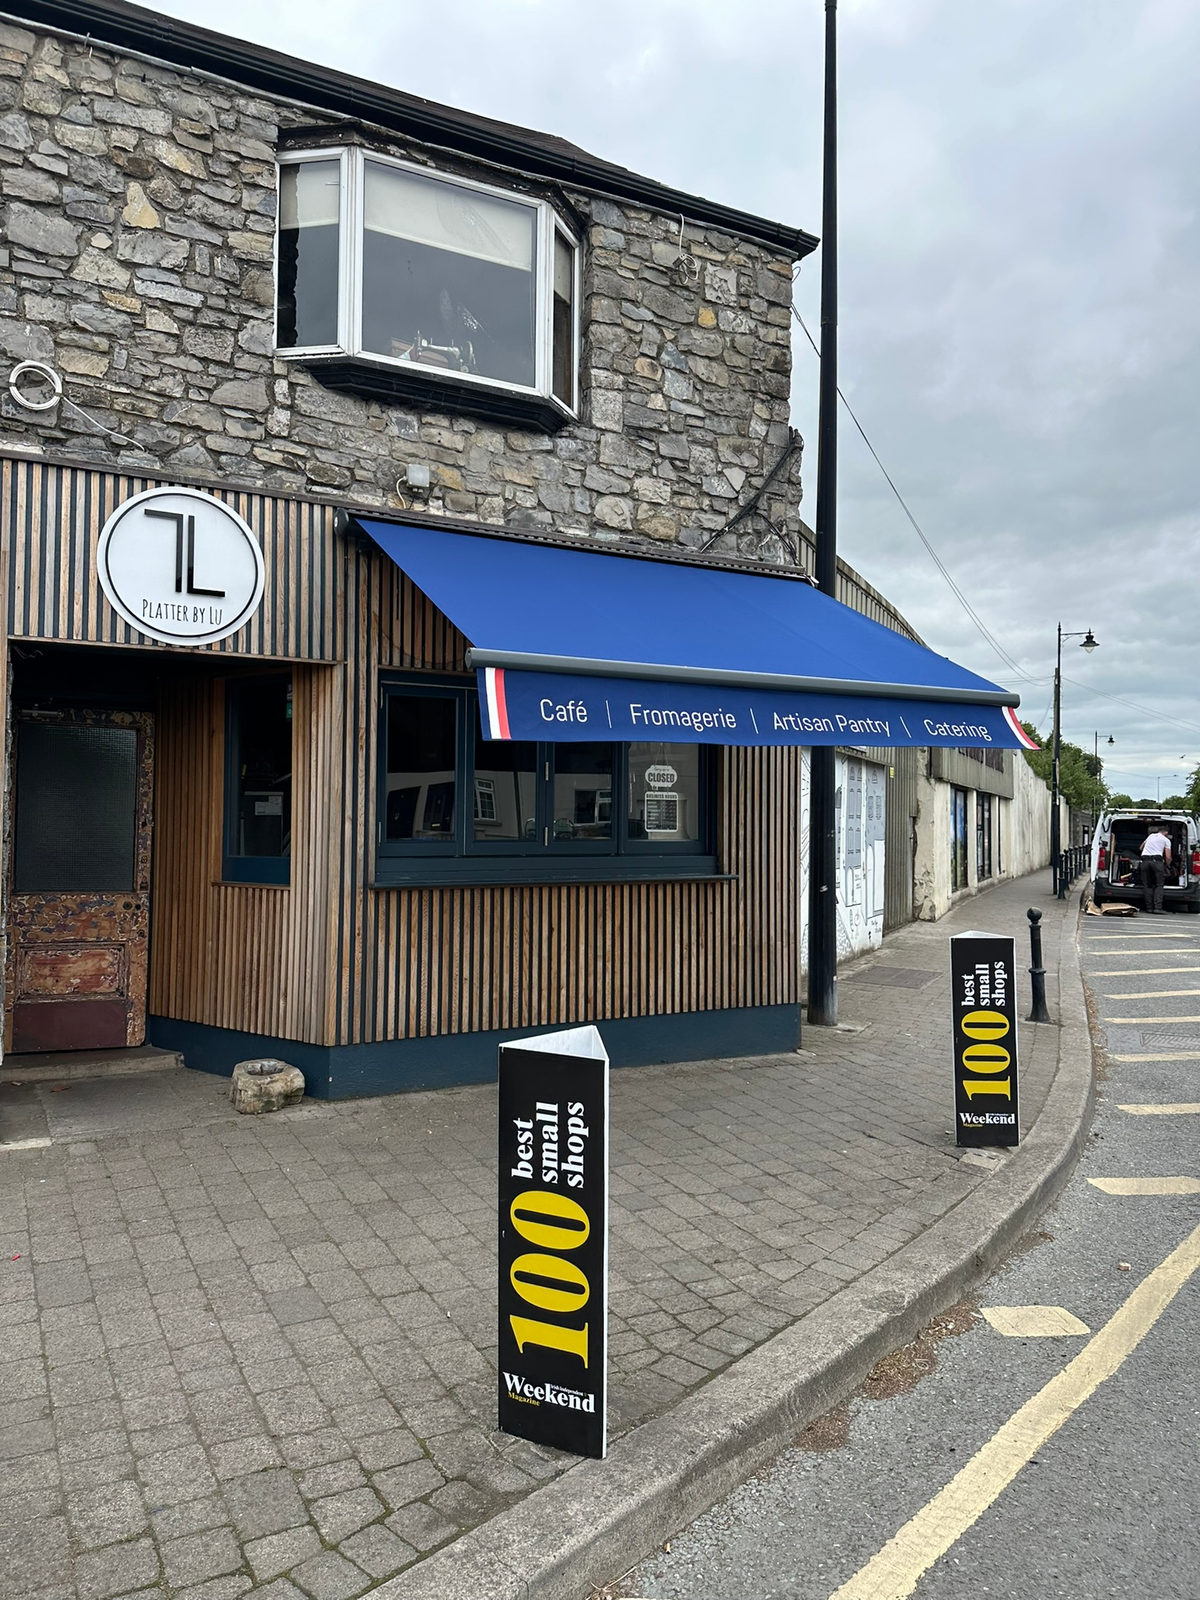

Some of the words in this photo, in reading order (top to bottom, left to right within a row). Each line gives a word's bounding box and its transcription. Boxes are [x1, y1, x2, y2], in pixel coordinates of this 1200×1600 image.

[142, 599, 189, 622] PLATTER
[540, 698, 588, 723] Café
[629, 703, 737, 732] Fromagerie
[773, 711, 834, 732] Artisan
[835, 714, 891, 738] Pantry
[923, 719, 993, 742] Catering
[647, 772, 676, 783] CLOSED
[961, 973, 976, 1007] best
[975, 963, 990, 1007] small
[991, 961, 1008, 1007] shops
[961, 1010, 1011, 1102] 100
[959, 1112, 1016, 1125] Weekend
[511, 1117, 534, 1179] best
[536, 1101, 559, 1184] small
[561, 1101, 590, 1189] shops
[509, 1190, 590, 1369] 100
[502, 1371, 596, 1413] Weekend
[507, 1391, 541, 1407] Magazine
